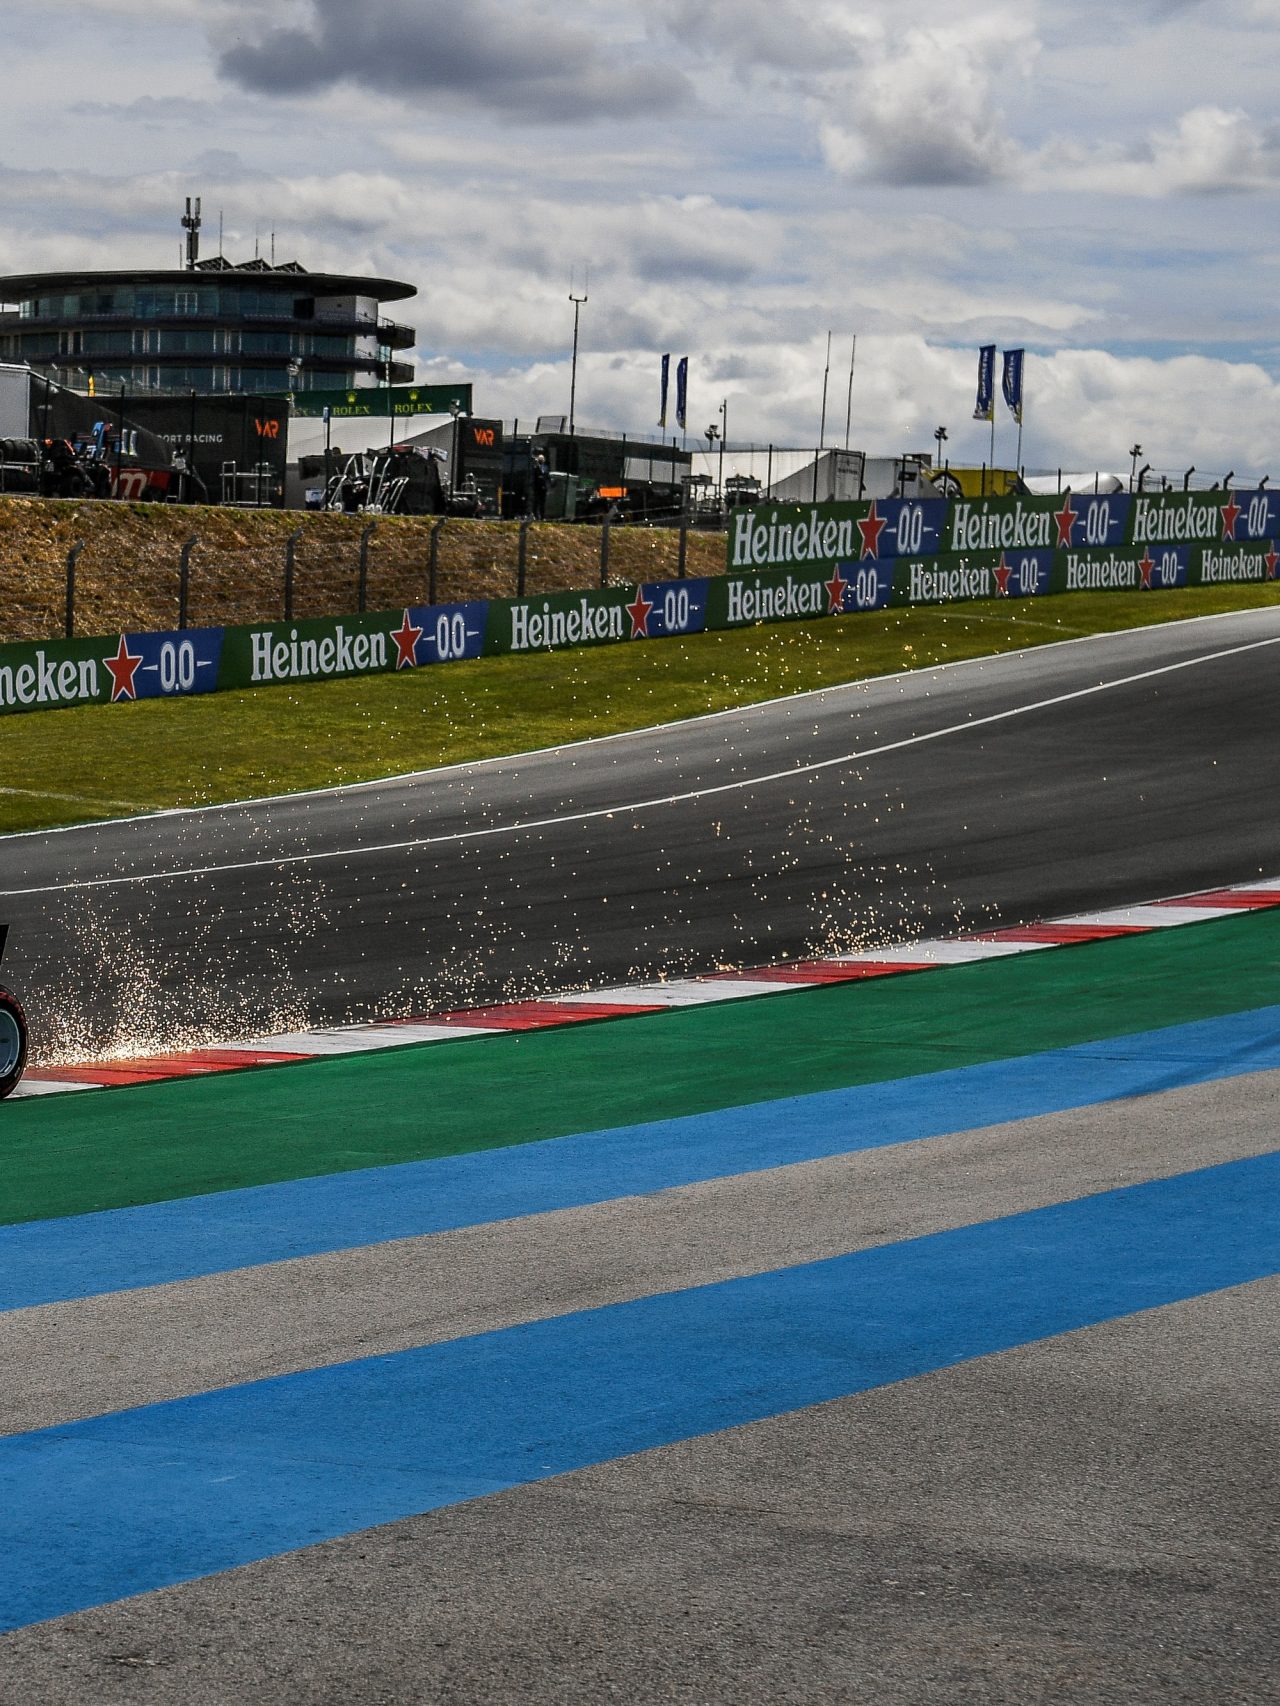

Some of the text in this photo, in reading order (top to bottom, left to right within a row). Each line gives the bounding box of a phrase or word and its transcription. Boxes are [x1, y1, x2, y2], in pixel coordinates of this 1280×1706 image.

[332, 406, 369, 416] ROLEX
[394, 403, 432, 414] ROLEX
[158, 434, 223, 443] ORT RACING
[732, 506, 922, 566] Heineken 0.0
[951, 501, 1109, 550] Heineken 0.0
[1133, 497, 1217, 541] Heineken
[910, 562, 990, 600] Heineken
[1066, 553, 1136, 589] Heineken
[1201, 548, 1262, 582] Heineken
[510, 588, 688, 650] Heineken 0.0
[727, 576, 822, 622] Heineken
[160, 640, 194, 692] 0.0
[250, 613, 466, 681] Heineken 0.0
